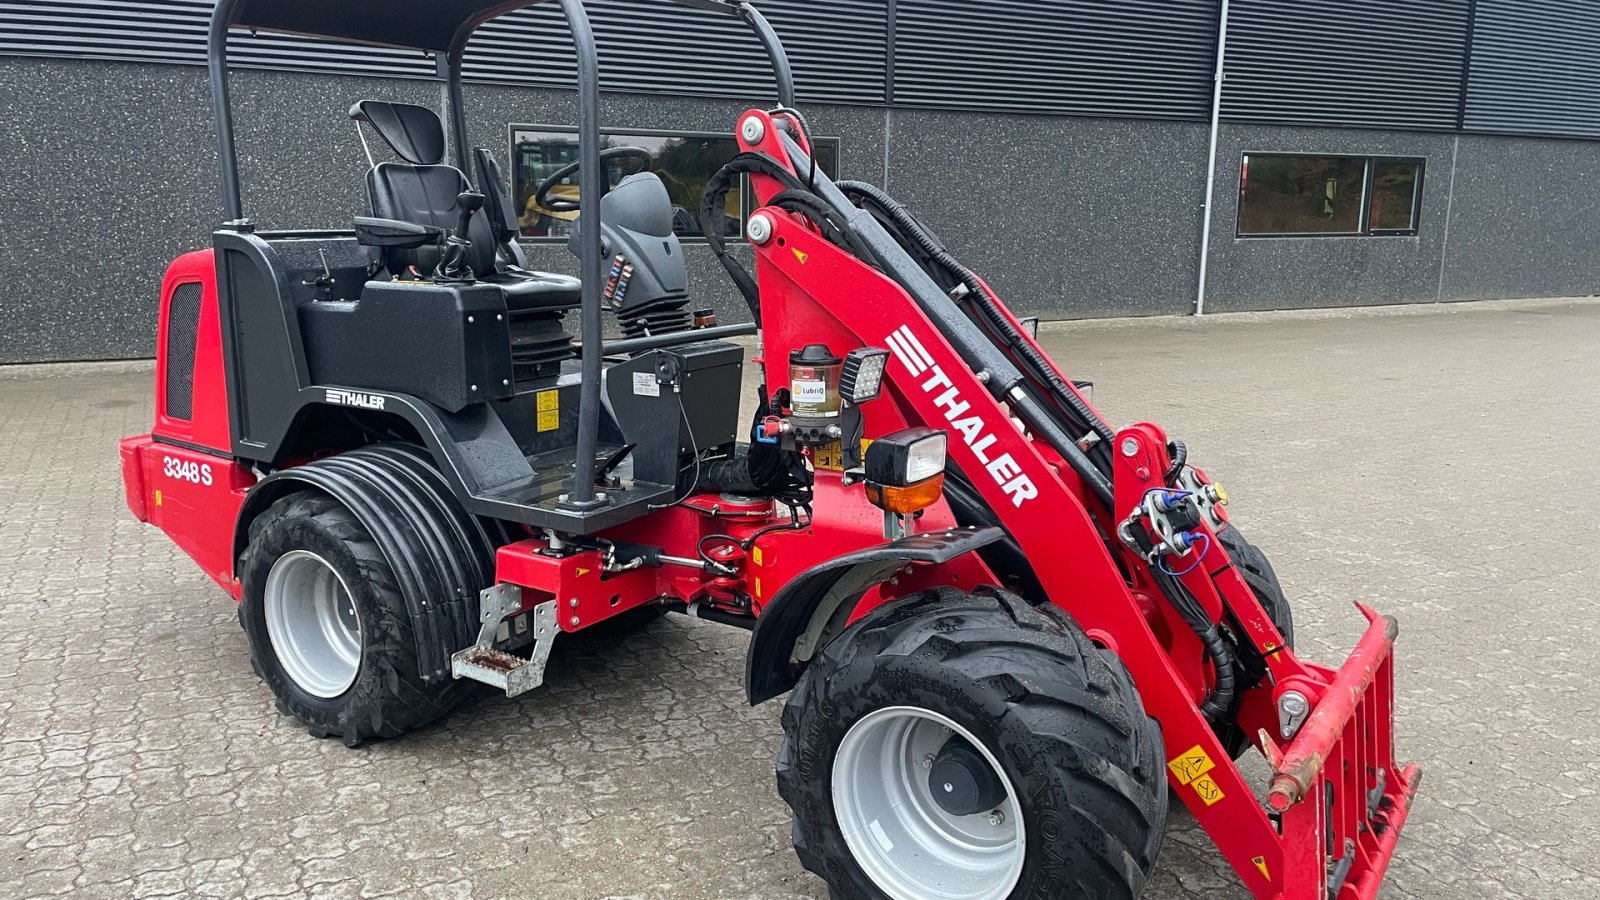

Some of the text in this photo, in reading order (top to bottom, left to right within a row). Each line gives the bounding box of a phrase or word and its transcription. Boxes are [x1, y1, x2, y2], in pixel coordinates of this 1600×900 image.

[341, 391, 385, 410] THALER
[802, 387, 824, 395] LubriQ
[921, 365, 1038, 508] THALER
[163, 456, 213, 486] 3348 S
